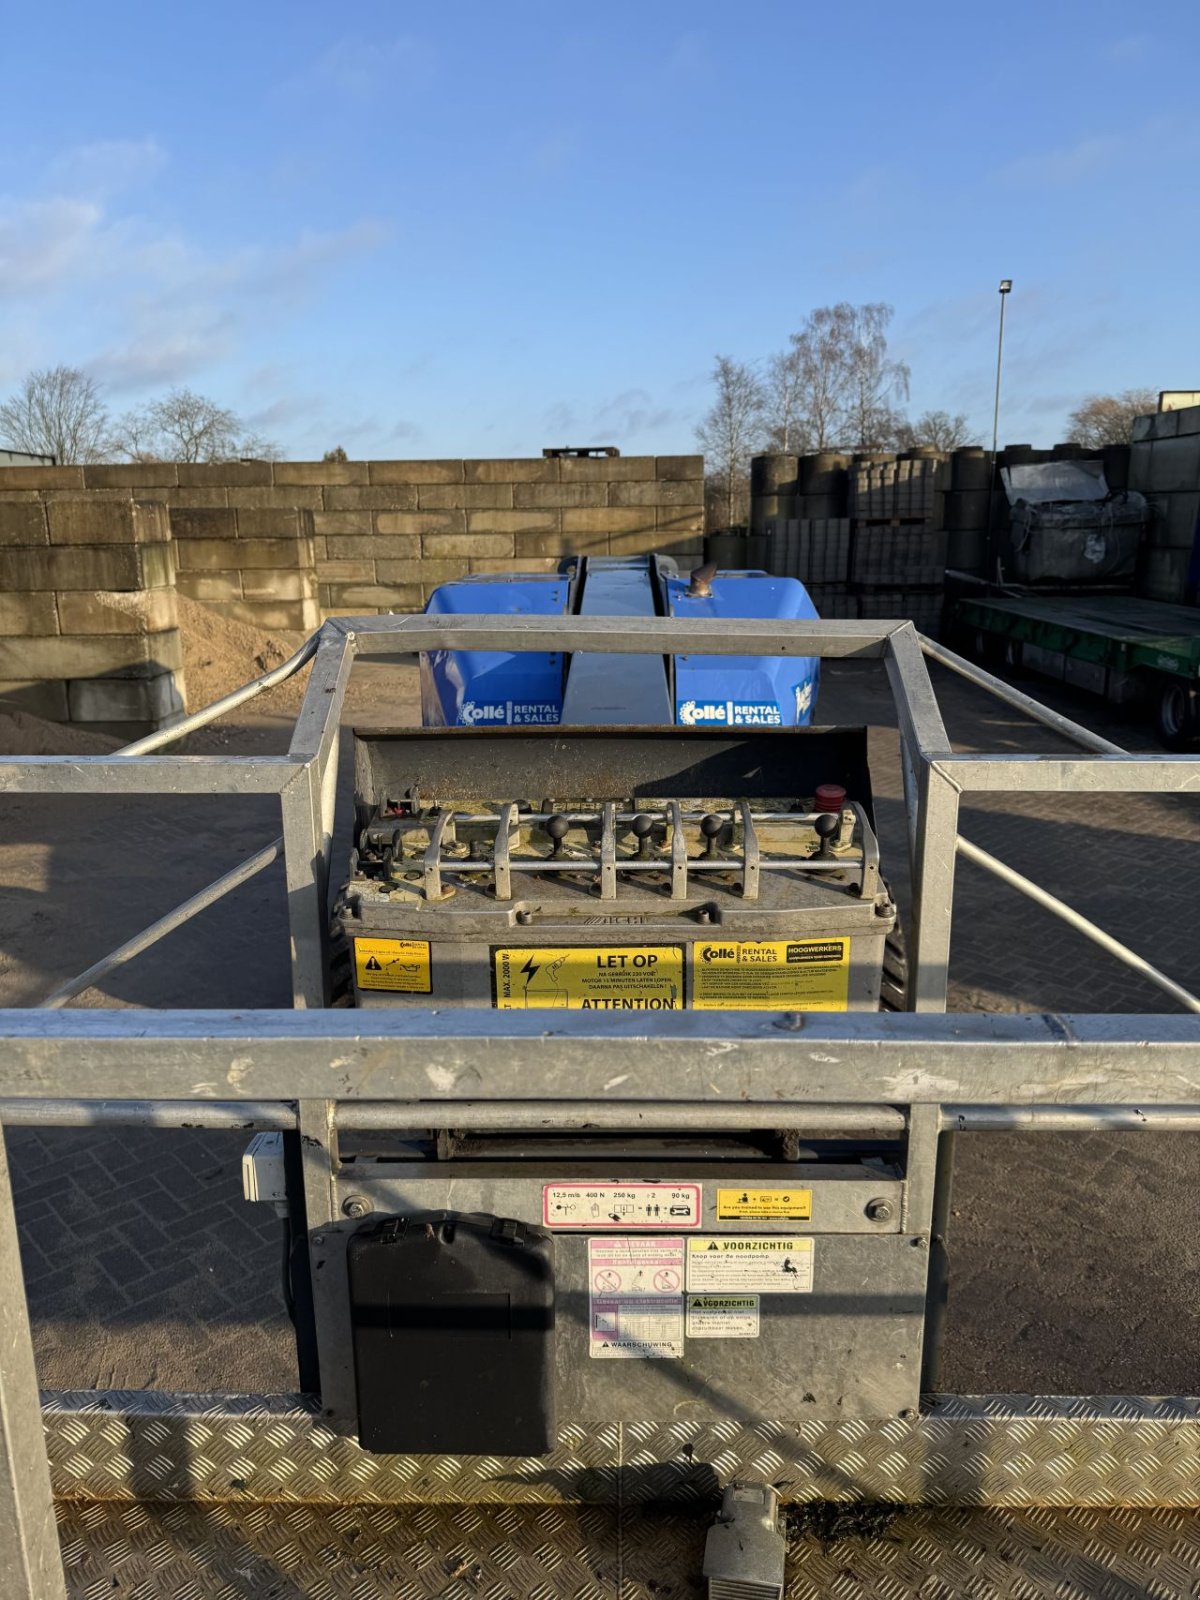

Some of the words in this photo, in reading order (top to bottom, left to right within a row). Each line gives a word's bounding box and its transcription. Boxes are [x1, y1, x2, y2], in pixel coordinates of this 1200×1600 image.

[460, 701, 505, 725] Collé
[514, 705, 559, 713] RENTAL
[680, 701, 726, 725] Collé
[735, 706, 780, 714] RENTAL
[514, 714, 523, 722] &
[524, 714, 559, 723] SALES
[735, 715, 743, 723] &
[745, 715, 780, 724] SALES
[788, 945, 842, 953] HOOGWERKERS
[502, 953, 509, 961] W
[701, 945, 735, 965] Collé
[751, 955, 777, 963] SALES
[597, 955, 628, 968] LET
[633, 954, 658, 968] OP
[502, 962, 510, 978] 2000
[503, 979, 511, 998] MAX.
[582, 998, 674, 1010] ATTENTION
[627, 1192, 636, 1200] kg
[724, 1242, 793, 1250] VOORZICHTIG
